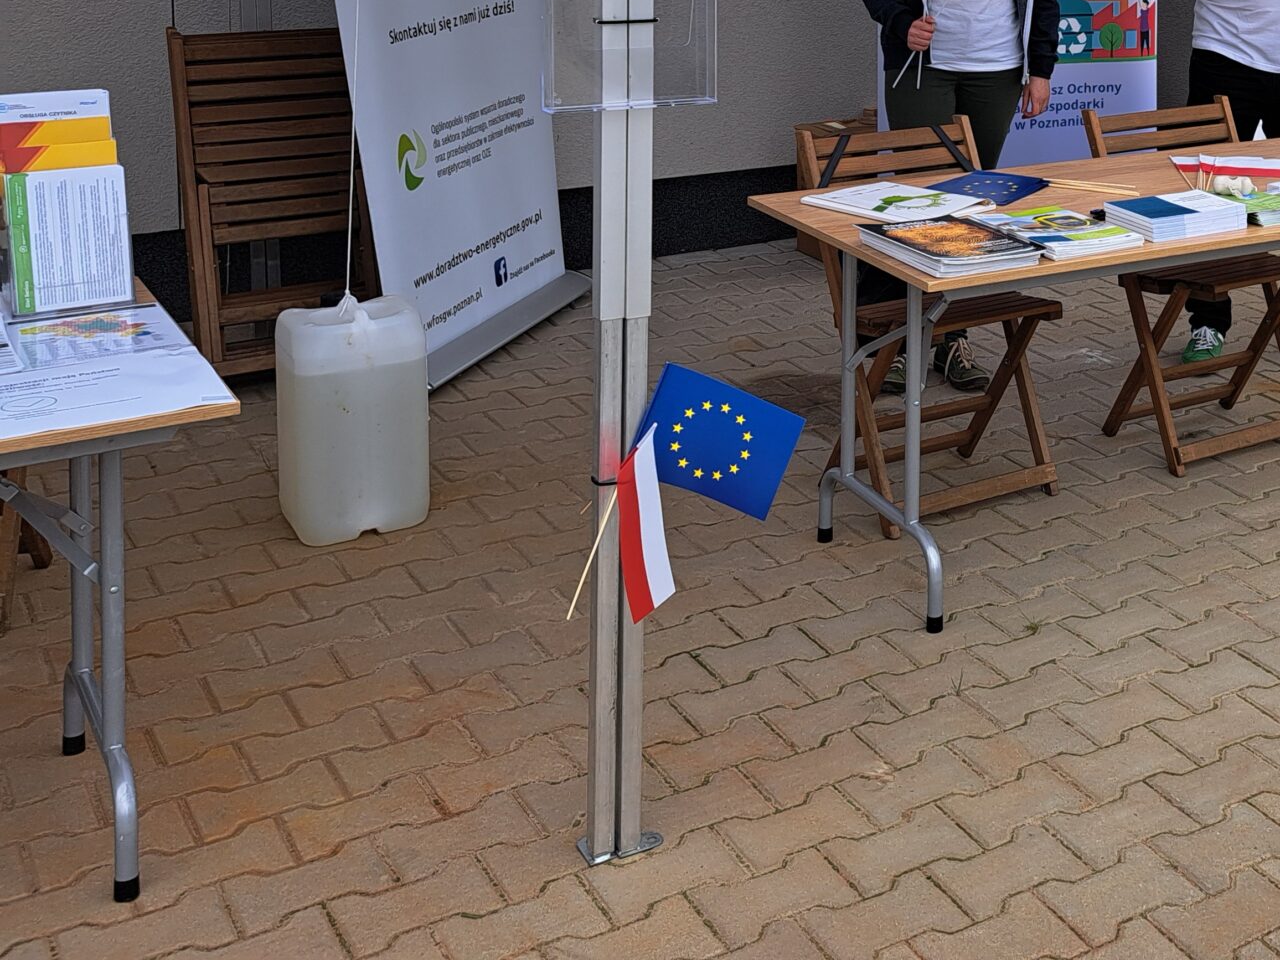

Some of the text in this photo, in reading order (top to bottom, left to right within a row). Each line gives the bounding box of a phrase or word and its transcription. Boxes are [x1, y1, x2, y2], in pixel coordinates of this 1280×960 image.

[388, 0, 516, 45] Skontaktuj się z nami już dziś!
[1066, 82, 1123, 96] Ochrony
[1014, 121, 1026, 130] w
[413, 208, 543, 289] www.doradztwo-energetyczne.gov.pl
